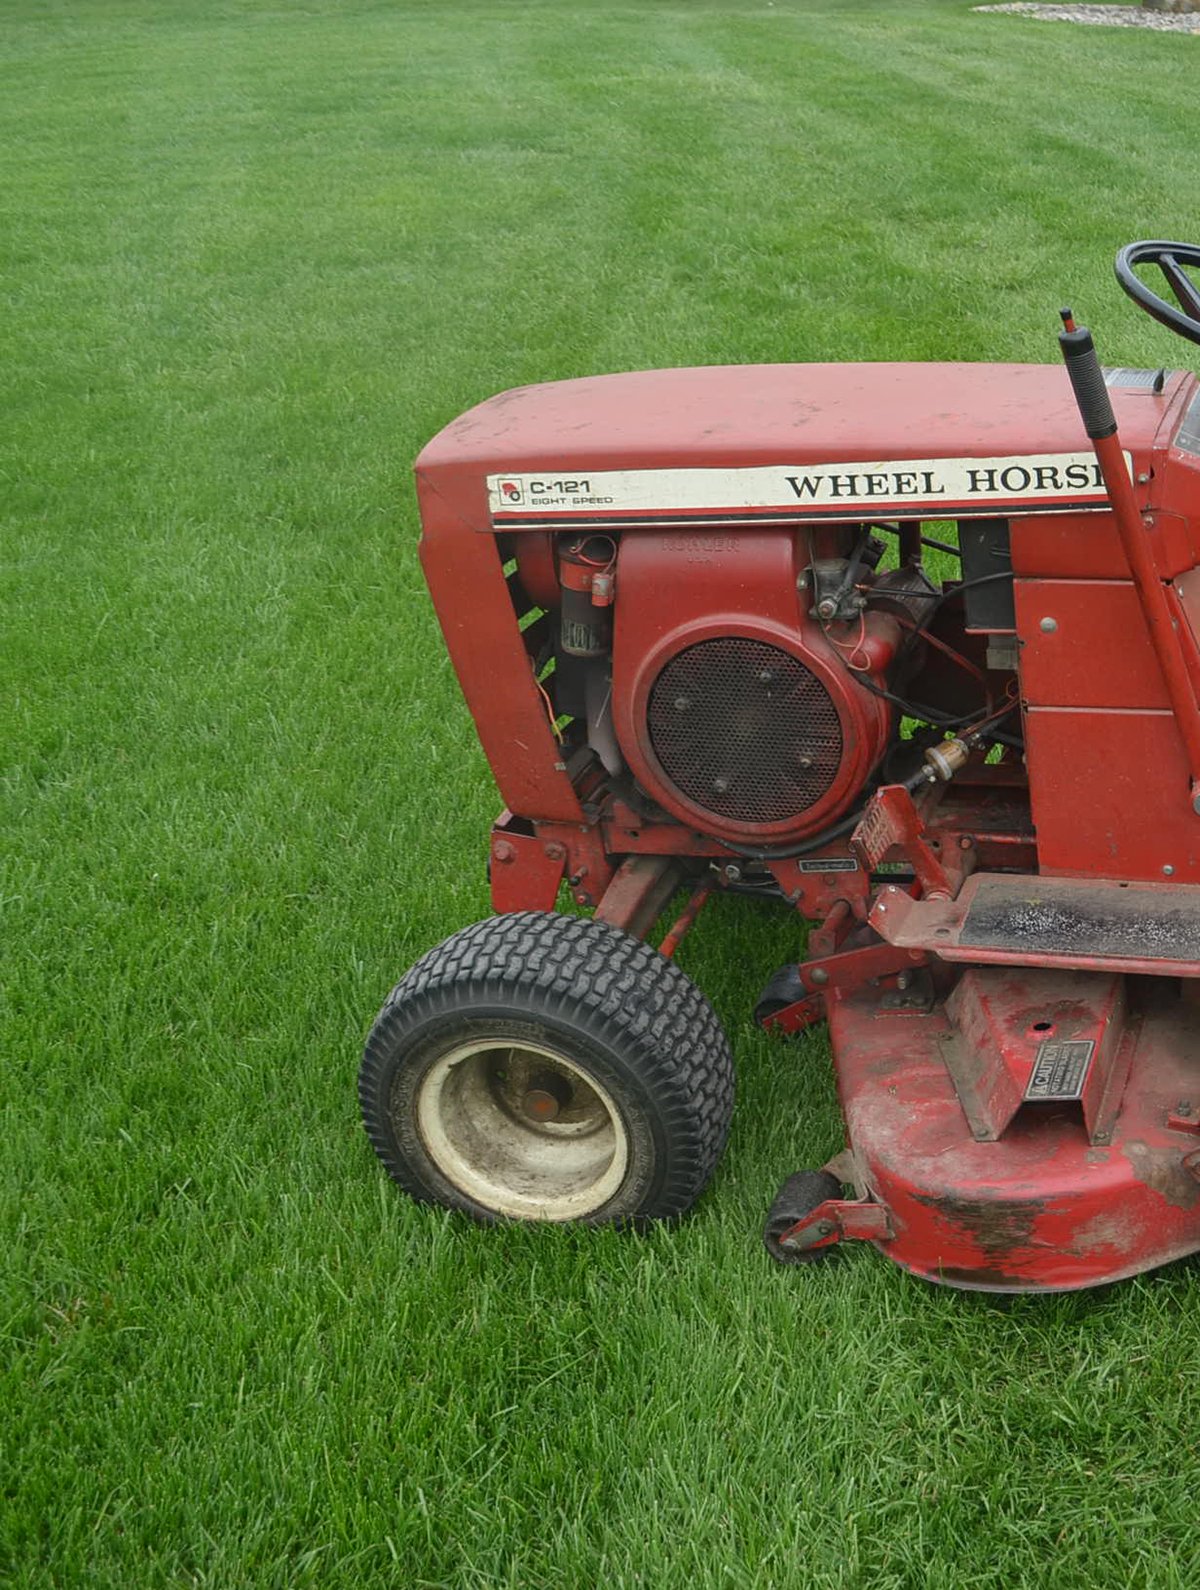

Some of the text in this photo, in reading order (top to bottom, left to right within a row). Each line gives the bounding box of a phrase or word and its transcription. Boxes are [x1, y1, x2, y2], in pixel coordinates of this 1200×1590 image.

[529, 480, 591, 494] C-121
[785, 470, 946, 498] WHEEL
[531, 496, 614, 506] EIGHT SPEED
